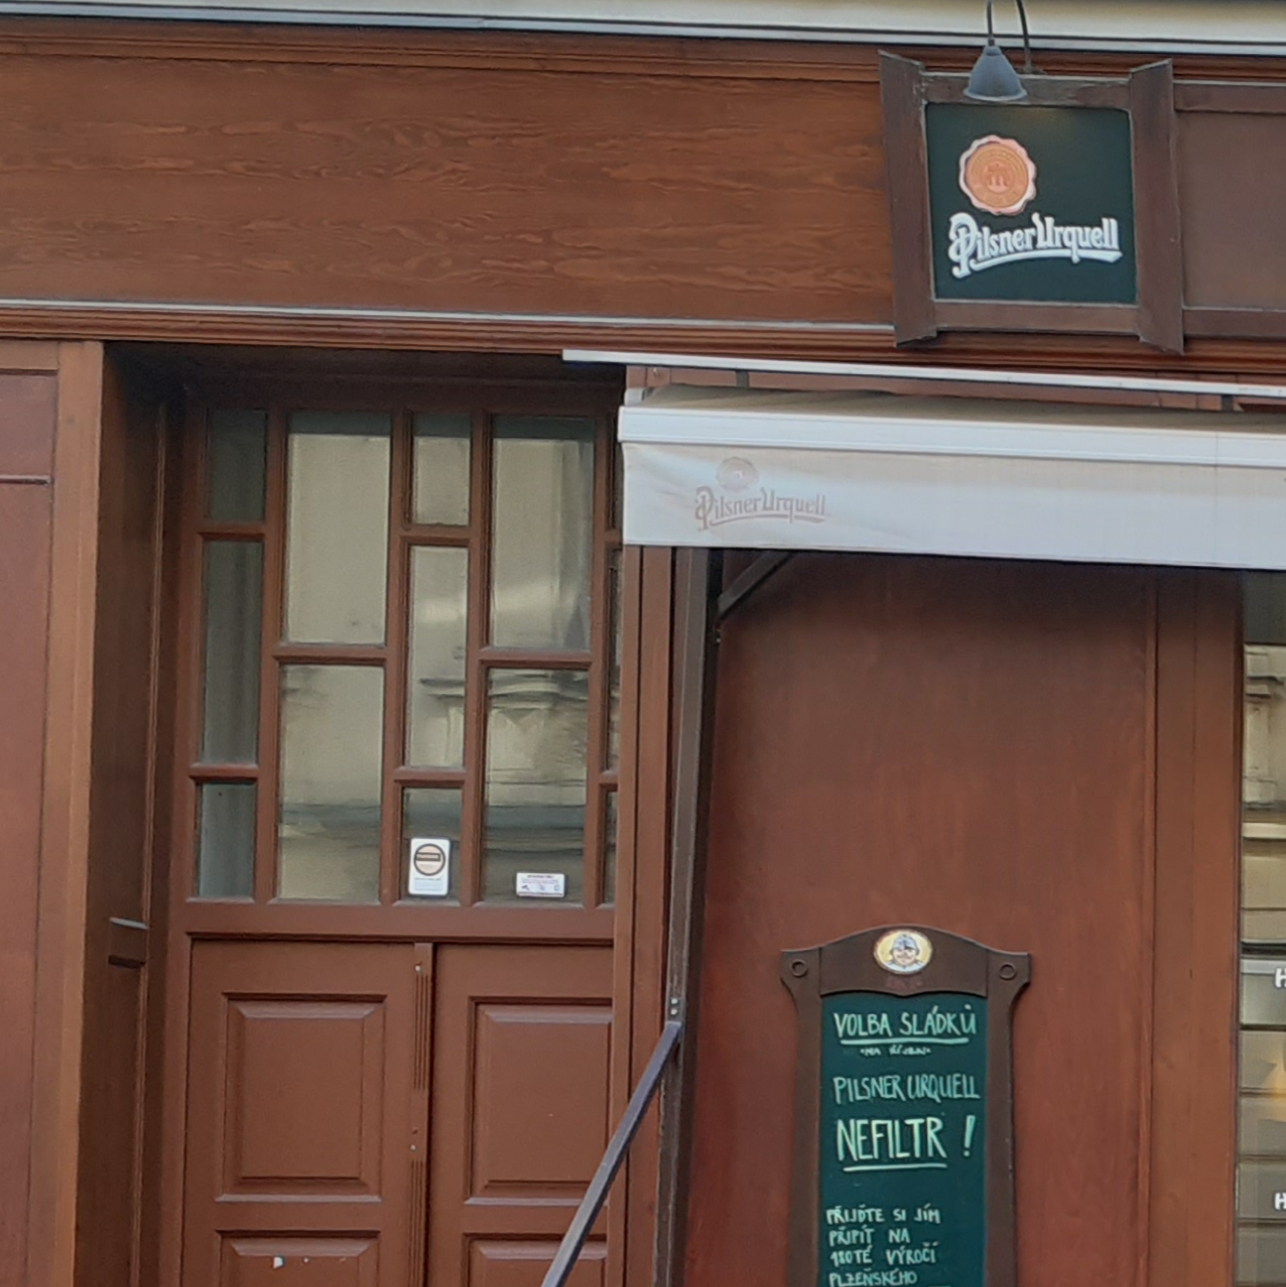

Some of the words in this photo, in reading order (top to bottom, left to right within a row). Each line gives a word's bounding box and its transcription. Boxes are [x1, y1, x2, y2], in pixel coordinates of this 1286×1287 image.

[948, 212, 1037, 279] Pilsner
[1031, 212, 1119, 264] Urquell
[695, 486, 761, 532] Pilsner
[761, 487, 827, 524] Urquell
[834, 1013, 892, 1037] VOLBA
[833, 1076, 906, 1104] PILSNER
[907, 1073, 981, 1103] URQUELL
[837, 1117, 947, 1161] NEFILTR
[893, 1208, 907, 1221] SI
[888, 1228, 910, 1243] NA
[886, 1241, 939, 1265] VÝROČÍ
